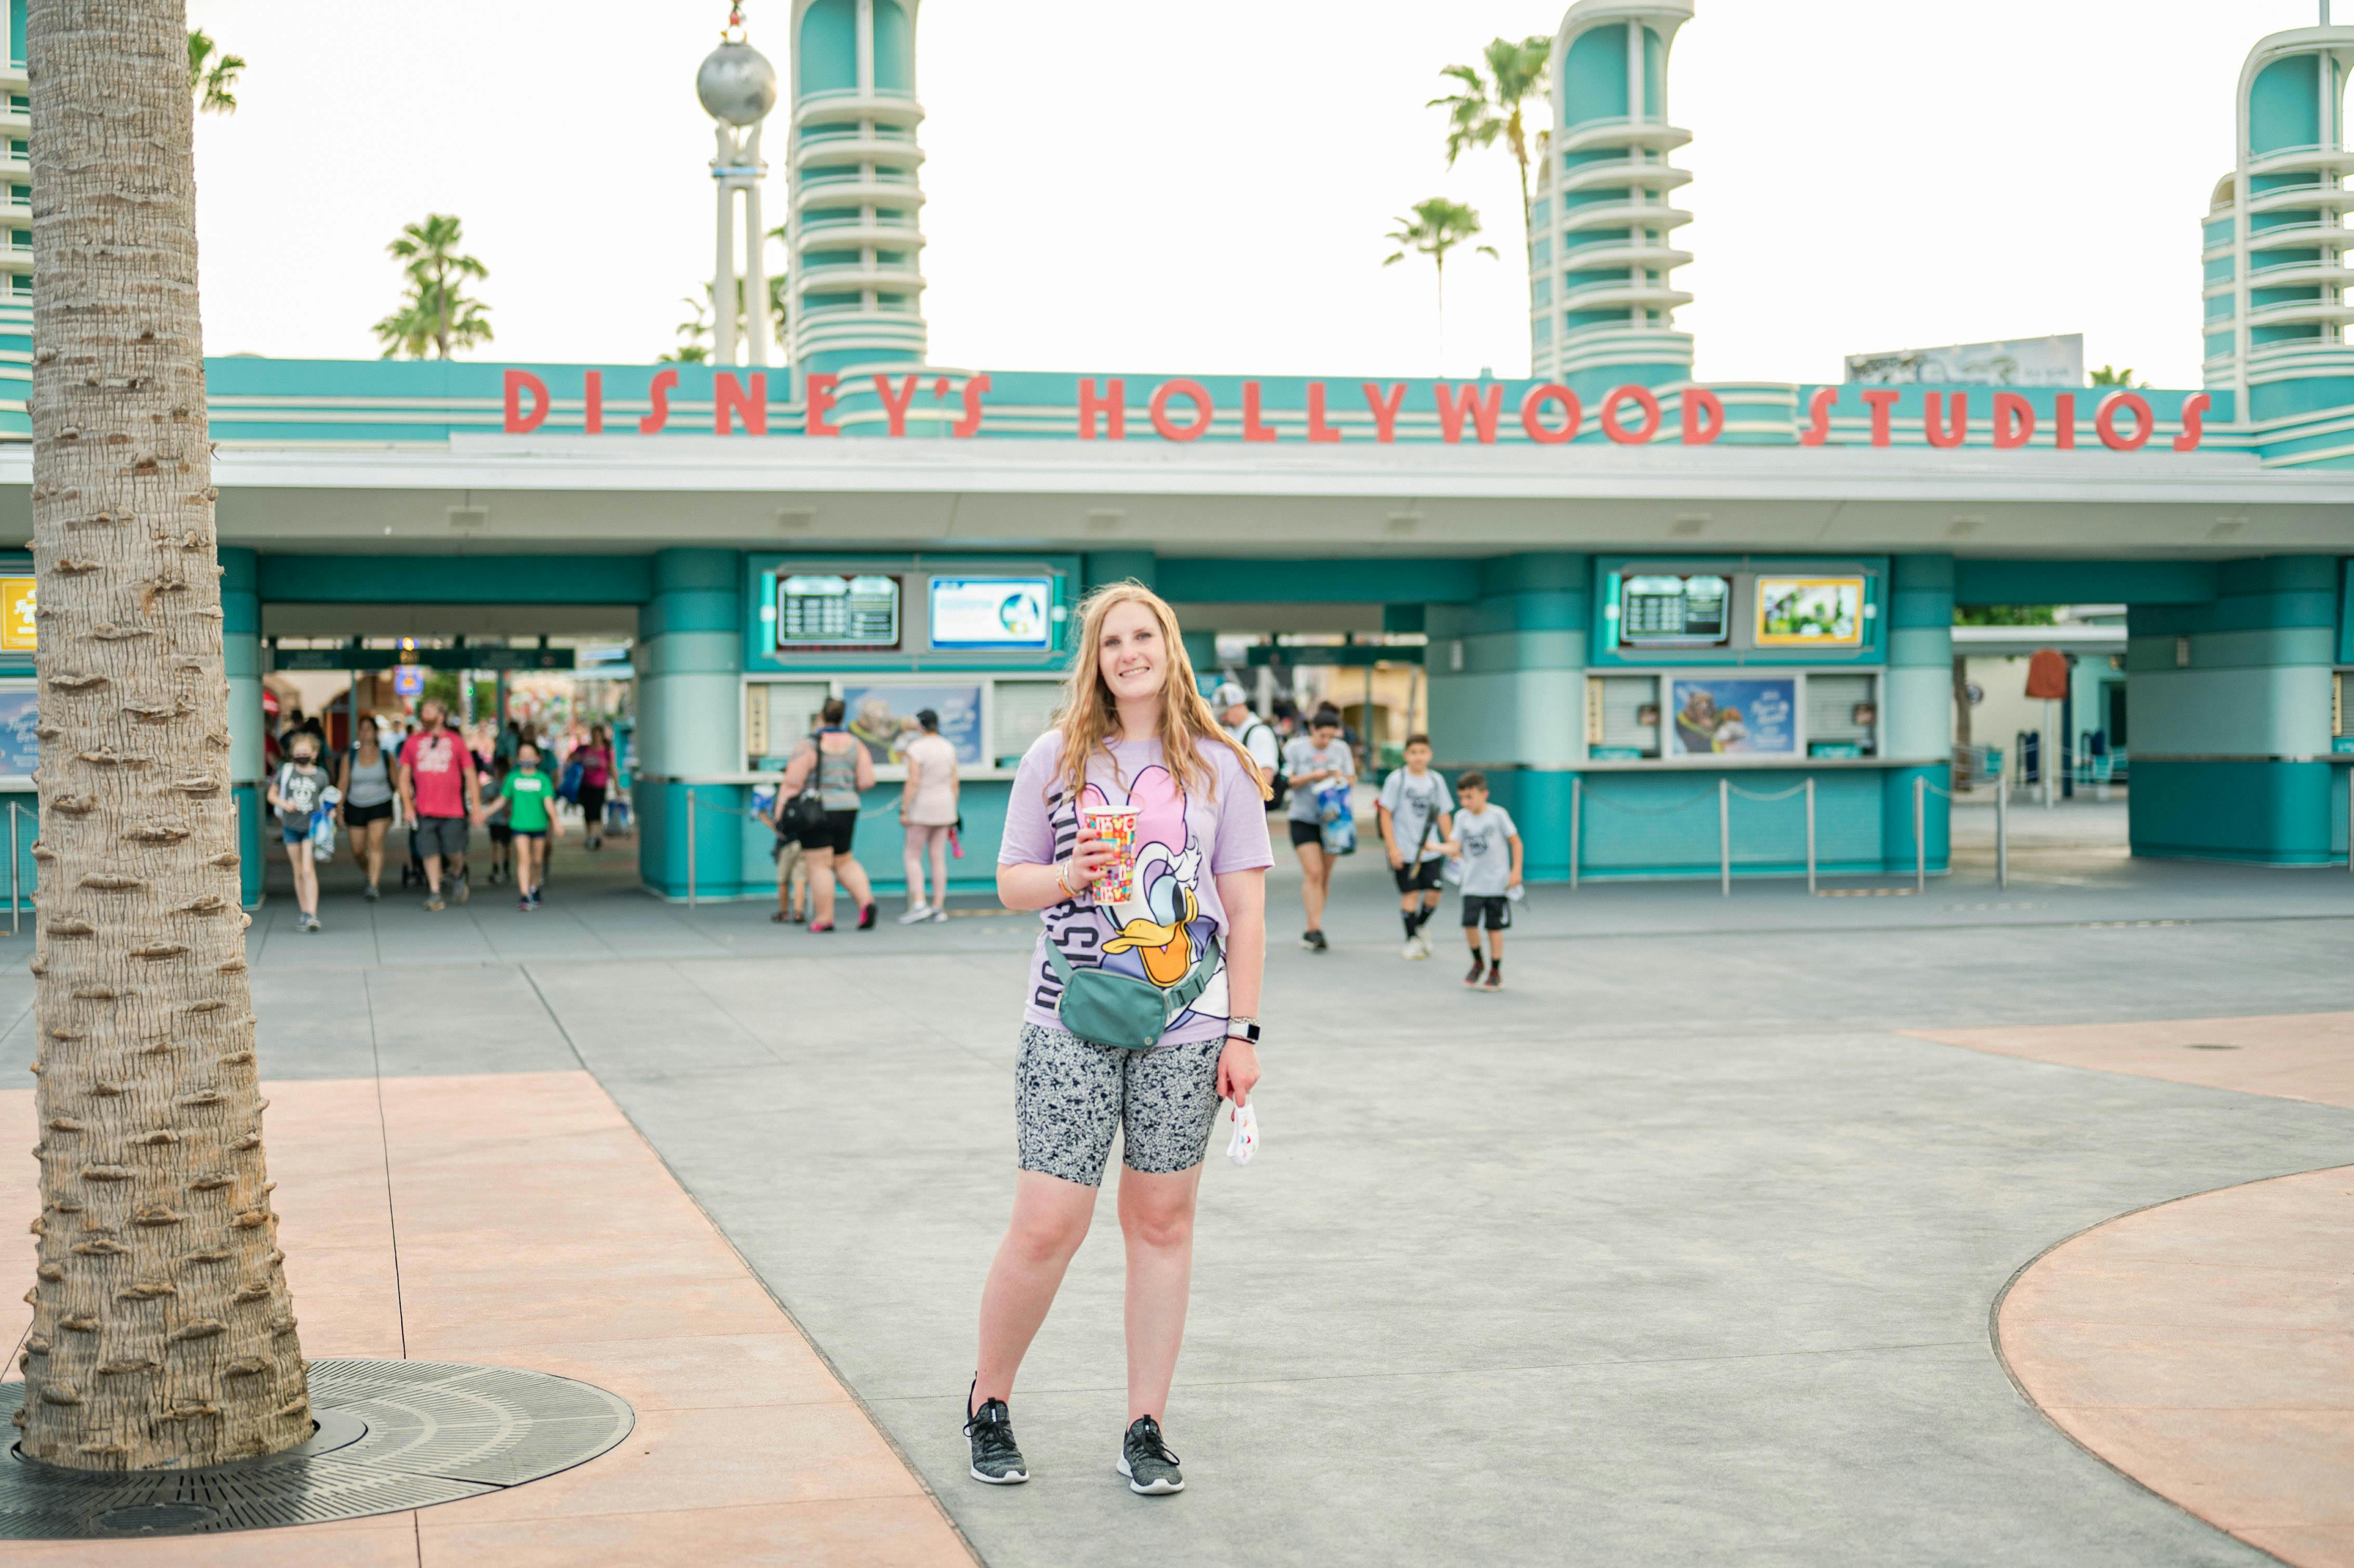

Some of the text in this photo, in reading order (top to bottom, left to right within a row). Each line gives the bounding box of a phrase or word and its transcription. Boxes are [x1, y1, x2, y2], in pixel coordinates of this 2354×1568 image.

[504, 370, 2210, 452] DISNEY'S HOLLYWOOD STUDIOS
